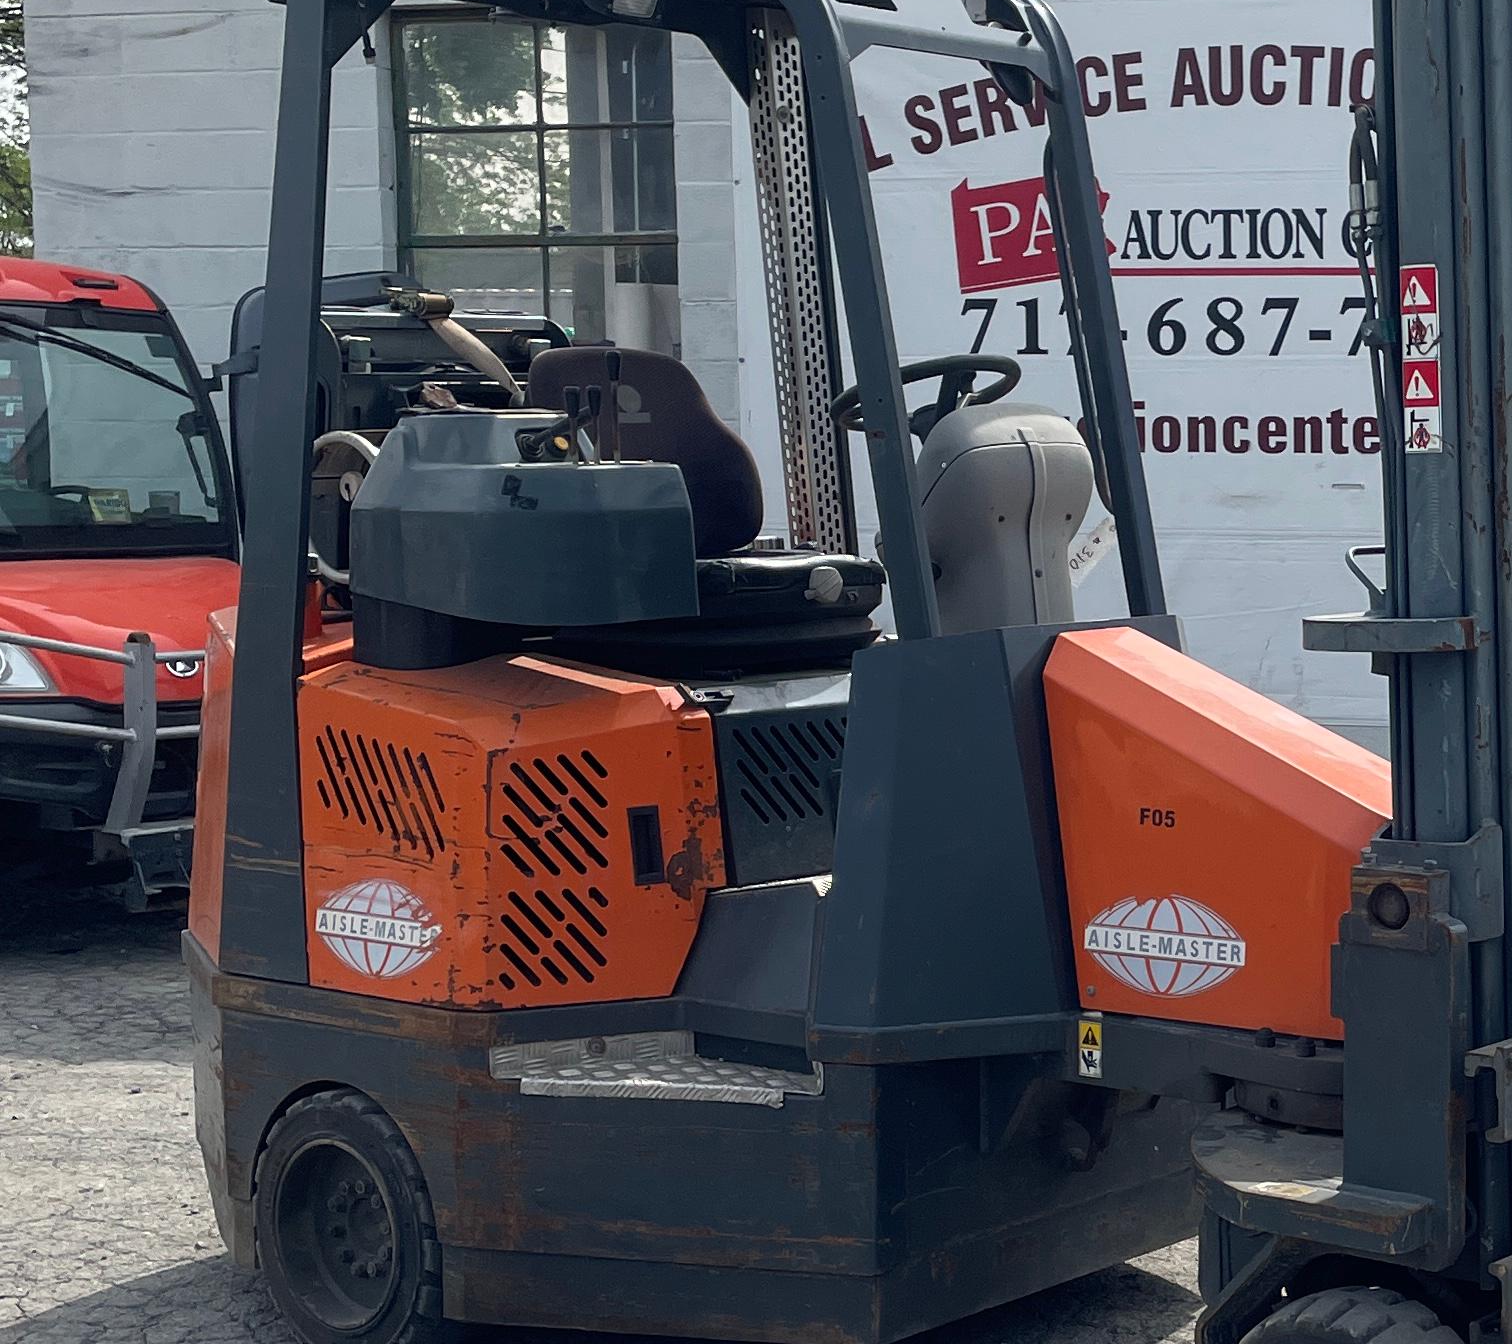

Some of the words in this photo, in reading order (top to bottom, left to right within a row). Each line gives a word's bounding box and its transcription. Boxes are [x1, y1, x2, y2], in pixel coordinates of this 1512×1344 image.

[904, 51, 1147, 155] SERVCE
[1170, 44, 1374, 107] AUCTIO
[1120, 208, 1327, 260] AUCTION
[1132, 401, 1381, 454] ioncente
[1139, 807, 1176, 828] F05
[1087, 929, 1242, 963] AISLE-MASTER
